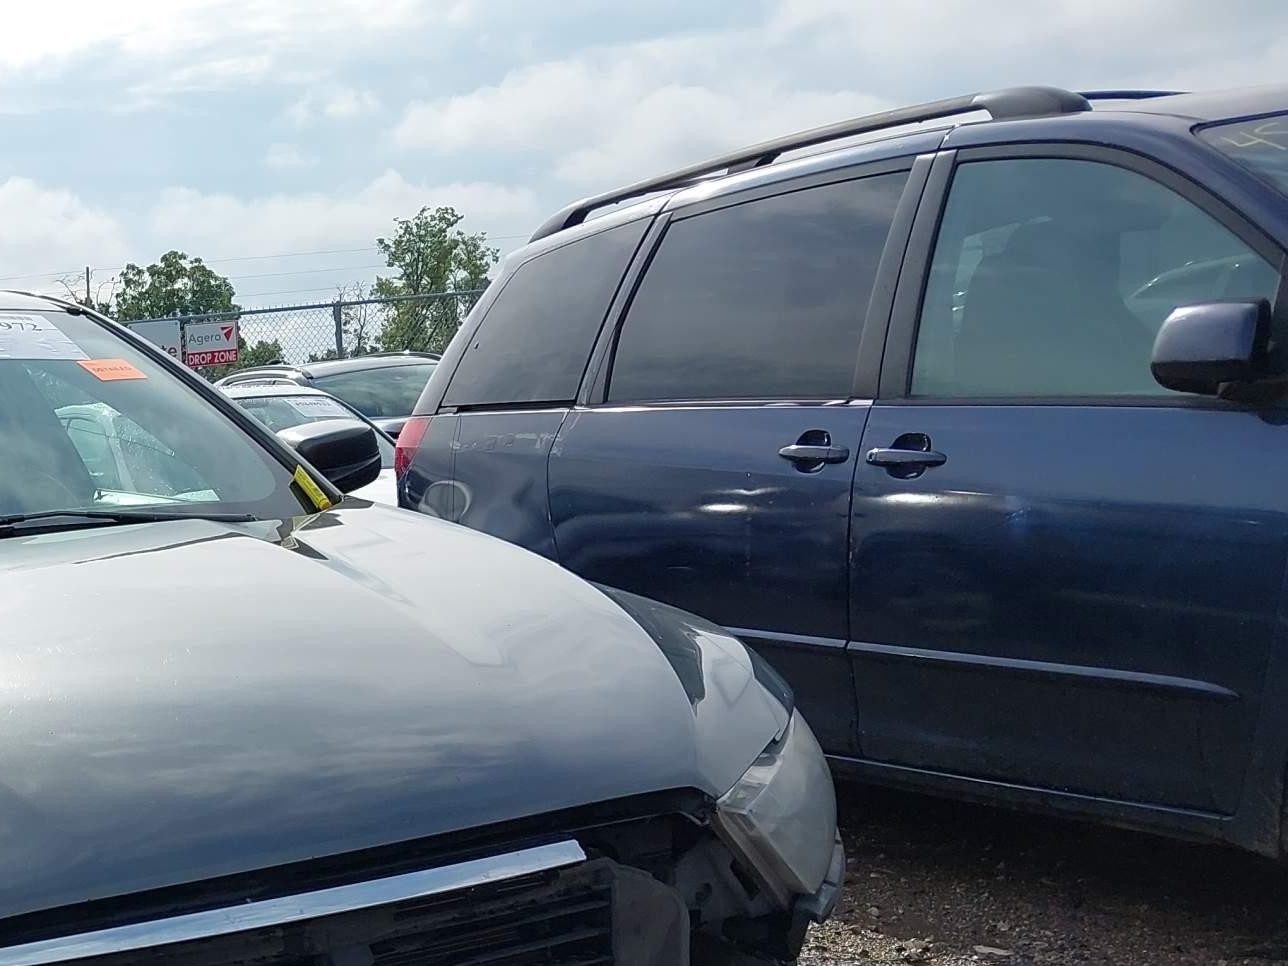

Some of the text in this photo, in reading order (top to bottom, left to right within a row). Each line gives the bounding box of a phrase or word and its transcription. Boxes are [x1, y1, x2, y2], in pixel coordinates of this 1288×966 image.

[189, 332, 222, 345] Agero
[188, 350, 237, 366] DROP ZONE
